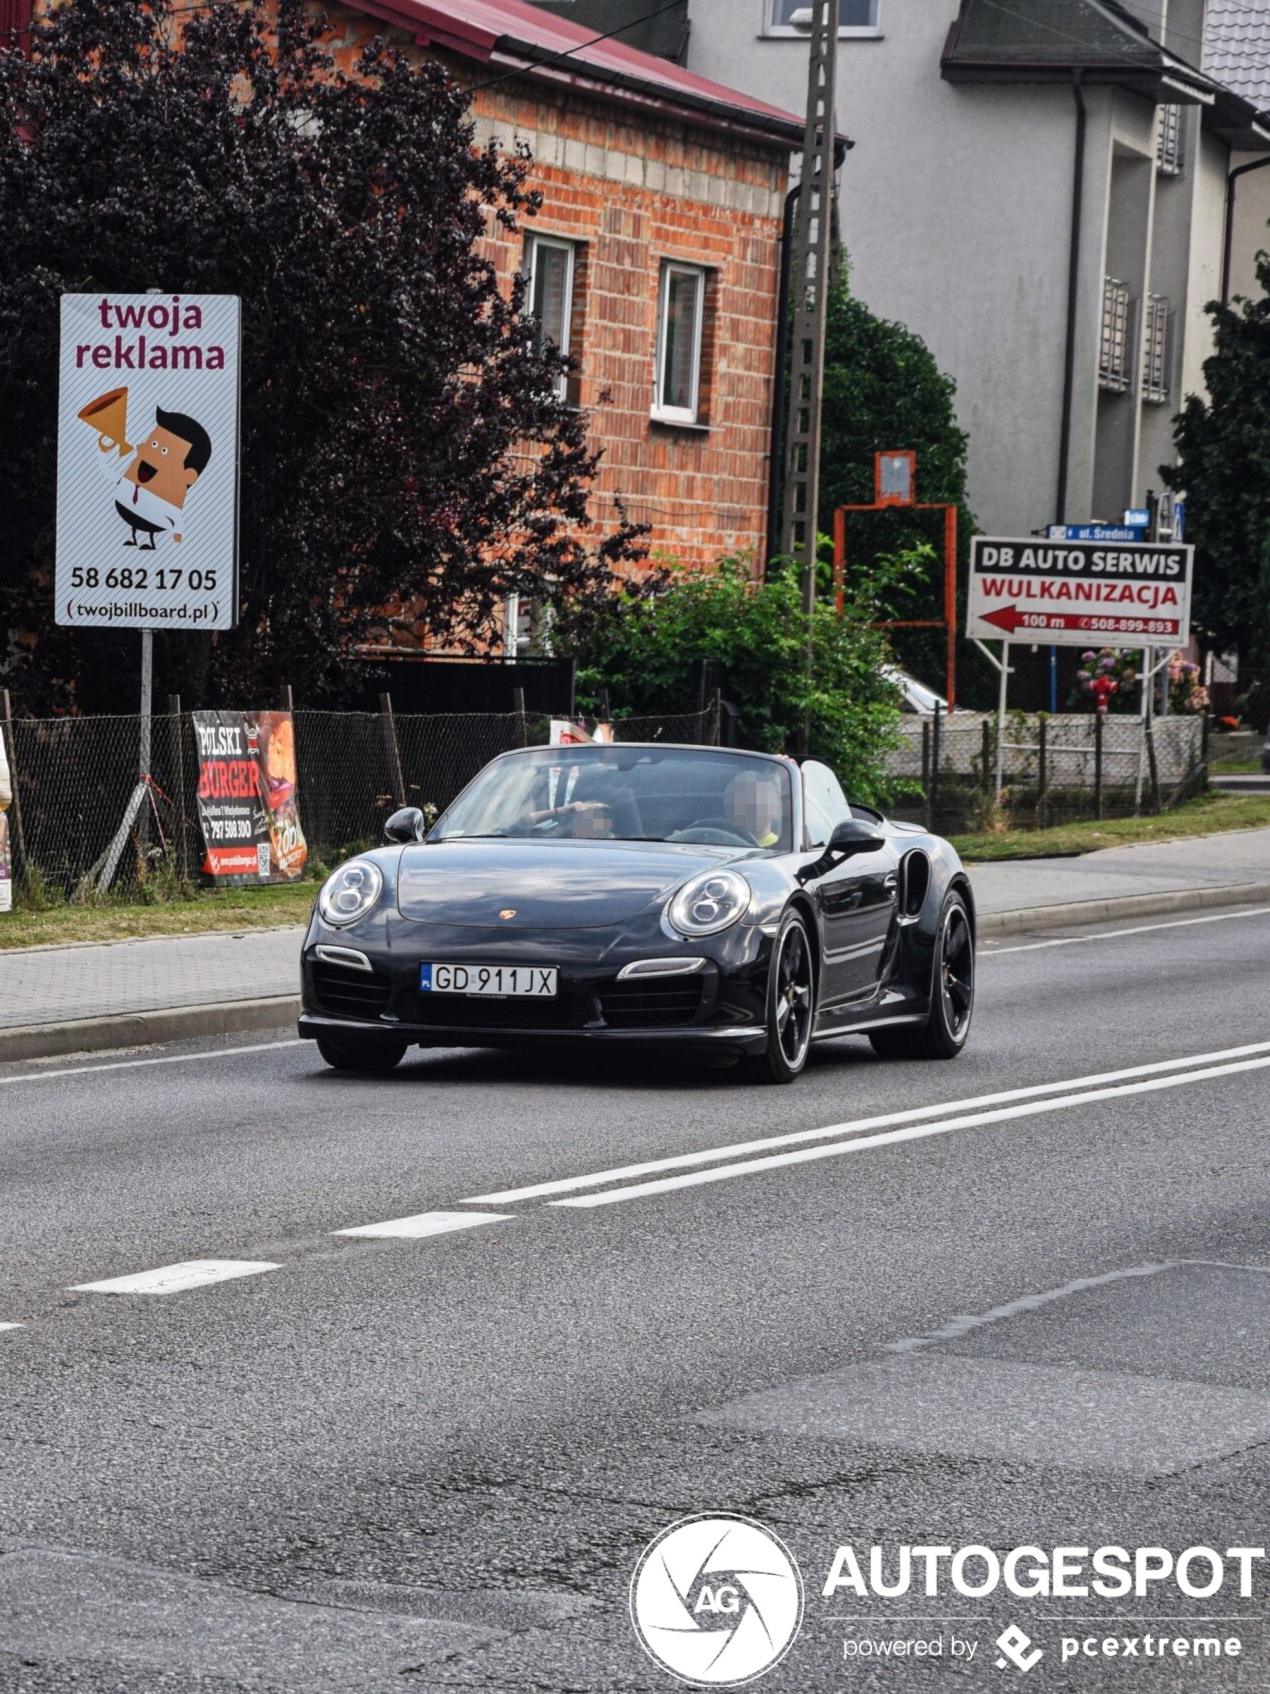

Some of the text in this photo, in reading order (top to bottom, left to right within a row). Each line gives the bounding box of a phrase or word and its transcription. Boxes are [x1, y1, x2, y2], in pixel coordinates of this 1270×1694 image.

[98, 295, 202, 336] twoja
[76, 336, 225, 370] reklama
[1079, 526, 1134, 539] ul. Średnia
[982, 547, 1180, 575] DB AUTO SERWIS
[71, 567, 216, 591] 58 682 17 05
[982, 578, 1178, 609] WULKANIZACJA
[1022, 615, 1173, 633] 100 m 508-899-893
[198, 727, 243, 756] POLSKI
[199, 760, 263, 799] BURGER
[436, 966, 552, 994] GD 911JX
